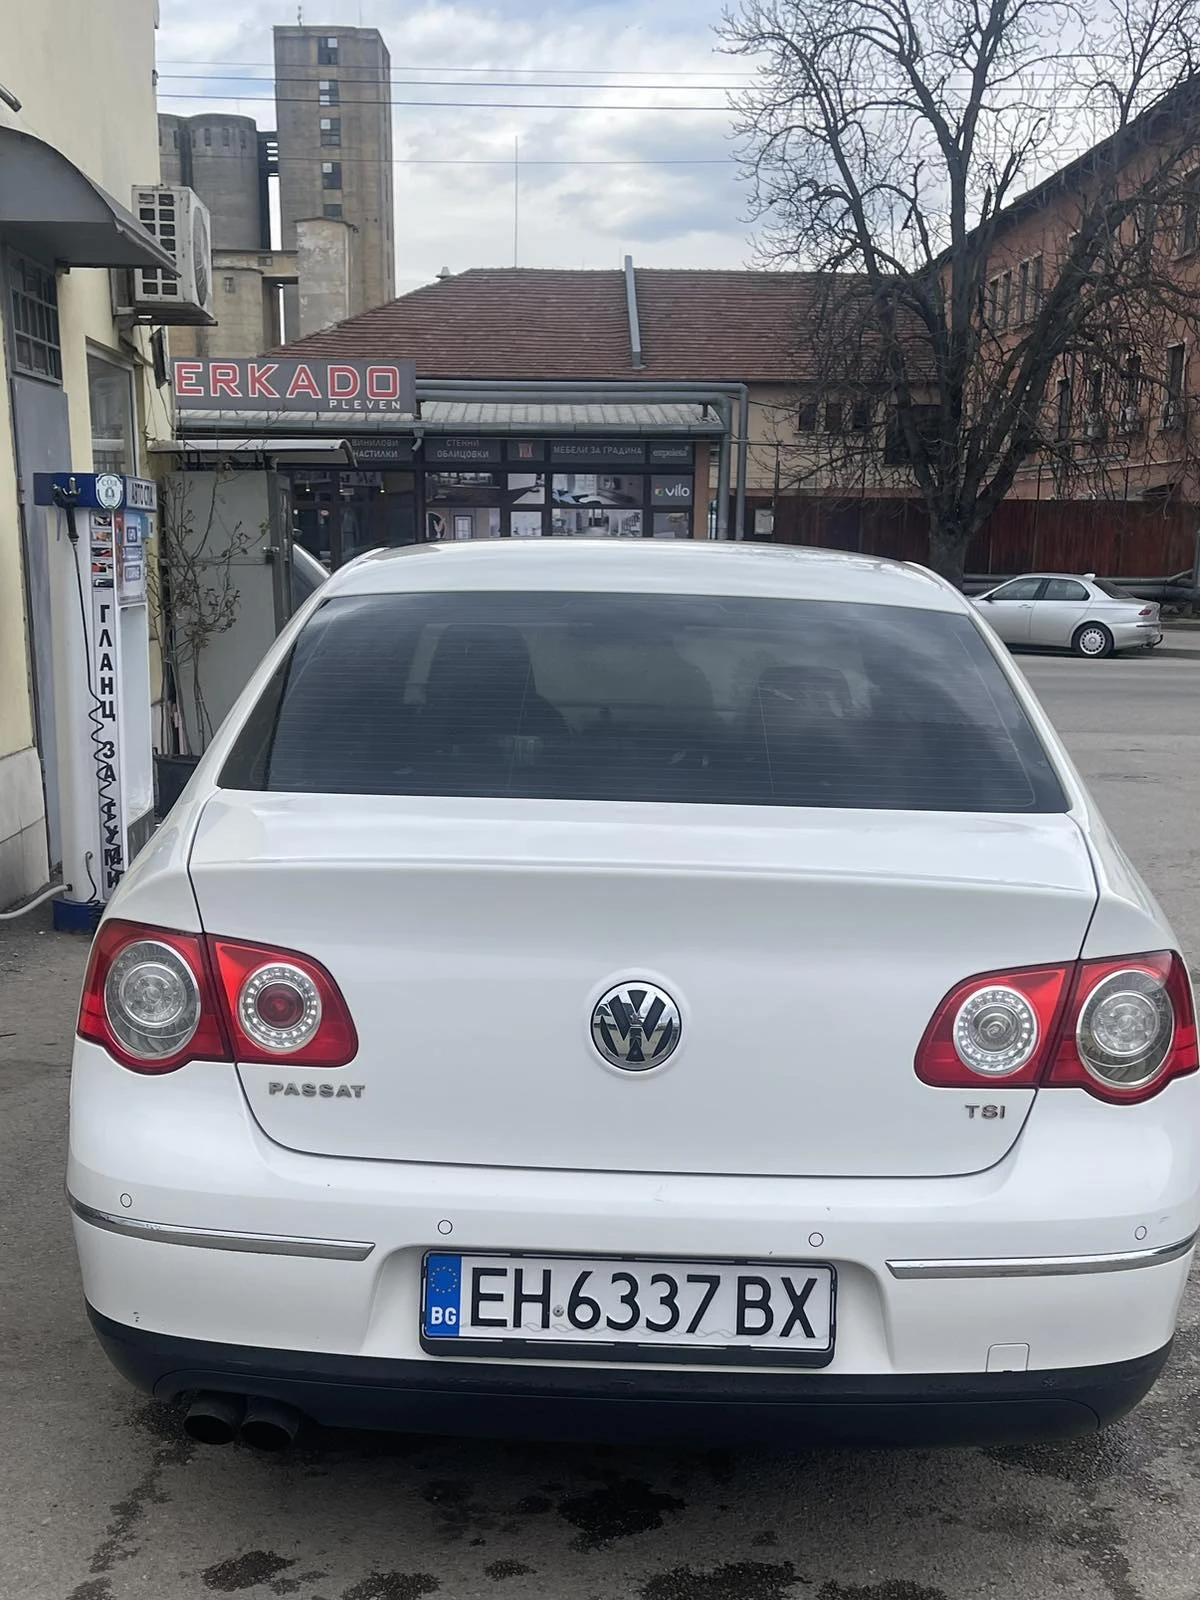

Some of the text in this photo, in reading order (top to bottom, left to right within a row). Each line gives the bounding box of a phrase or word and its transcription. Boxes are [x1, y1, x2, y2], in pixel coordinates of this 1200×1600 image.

[174, 361, 400, 400] ERKADO
[329, 400, 401, 410] PLEVEN
[436, 449, 489, 459] ОБЛИЦОВКИ
[552, 446, 588, 455] МЕБЕЛИ
[591, 446, 601, 455] ЗА
[602, 446, 642, 456] ГРАДИНА
[665, 483, 690, 497] vilo
[98, 604, 116, 722] ГЛАНЦ
[103, 740, 117, 782] ЗА
[268, 1082, 366, 1098] PASSAT
[964, 1104, 1006, 1119] TSI
[431, 1266, 818, 1339] BG EH 6337 BX
